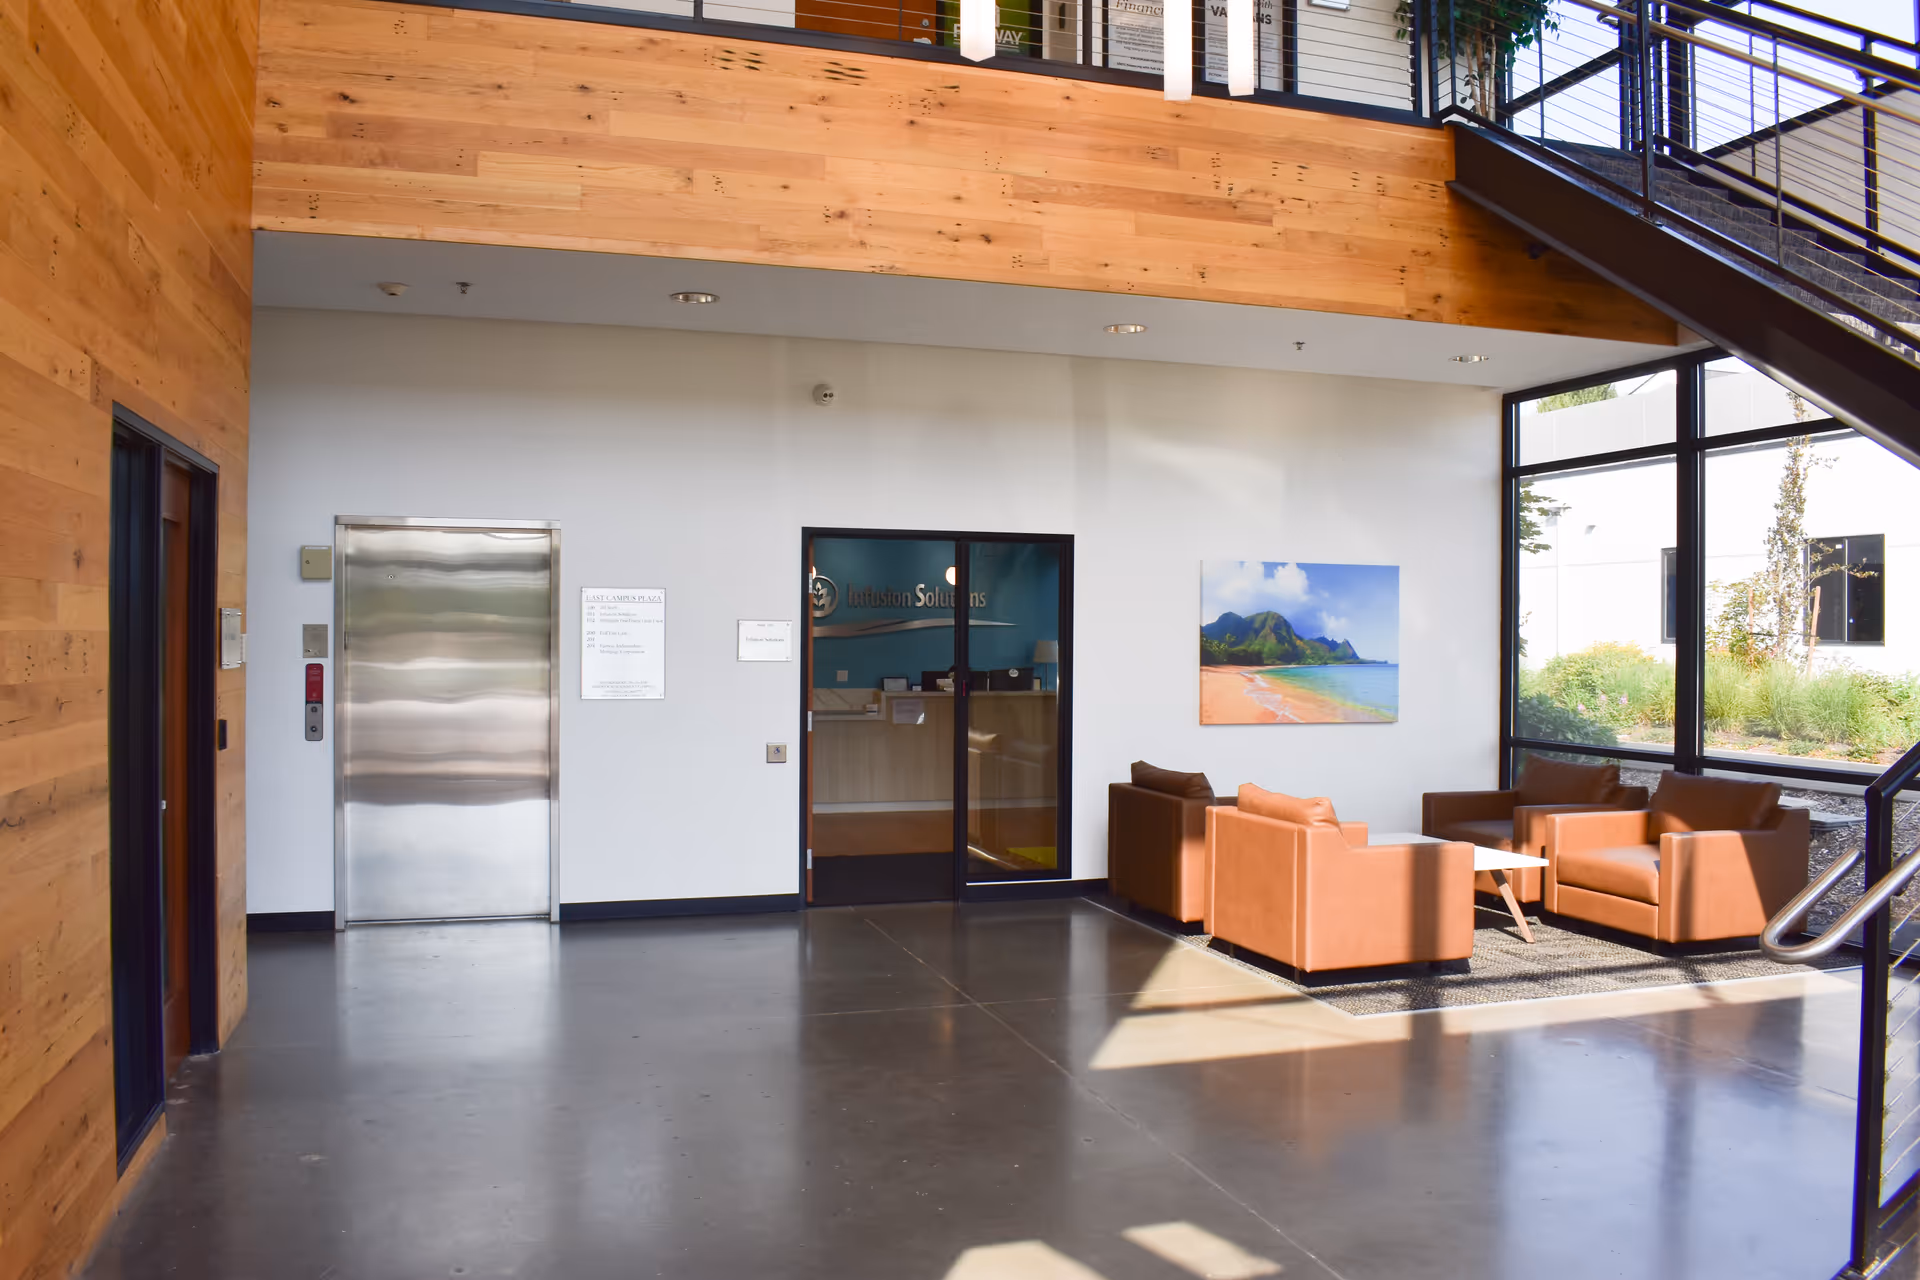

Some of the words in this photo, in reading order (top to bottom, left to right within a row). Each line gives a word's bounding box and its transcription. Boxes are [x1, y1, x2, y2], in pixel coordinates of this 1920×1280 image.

[606, 594, 637, 602] CAMPUS
[848, 583, 911, 608] Infusion
[915, 583, 986, 608] Solutns
